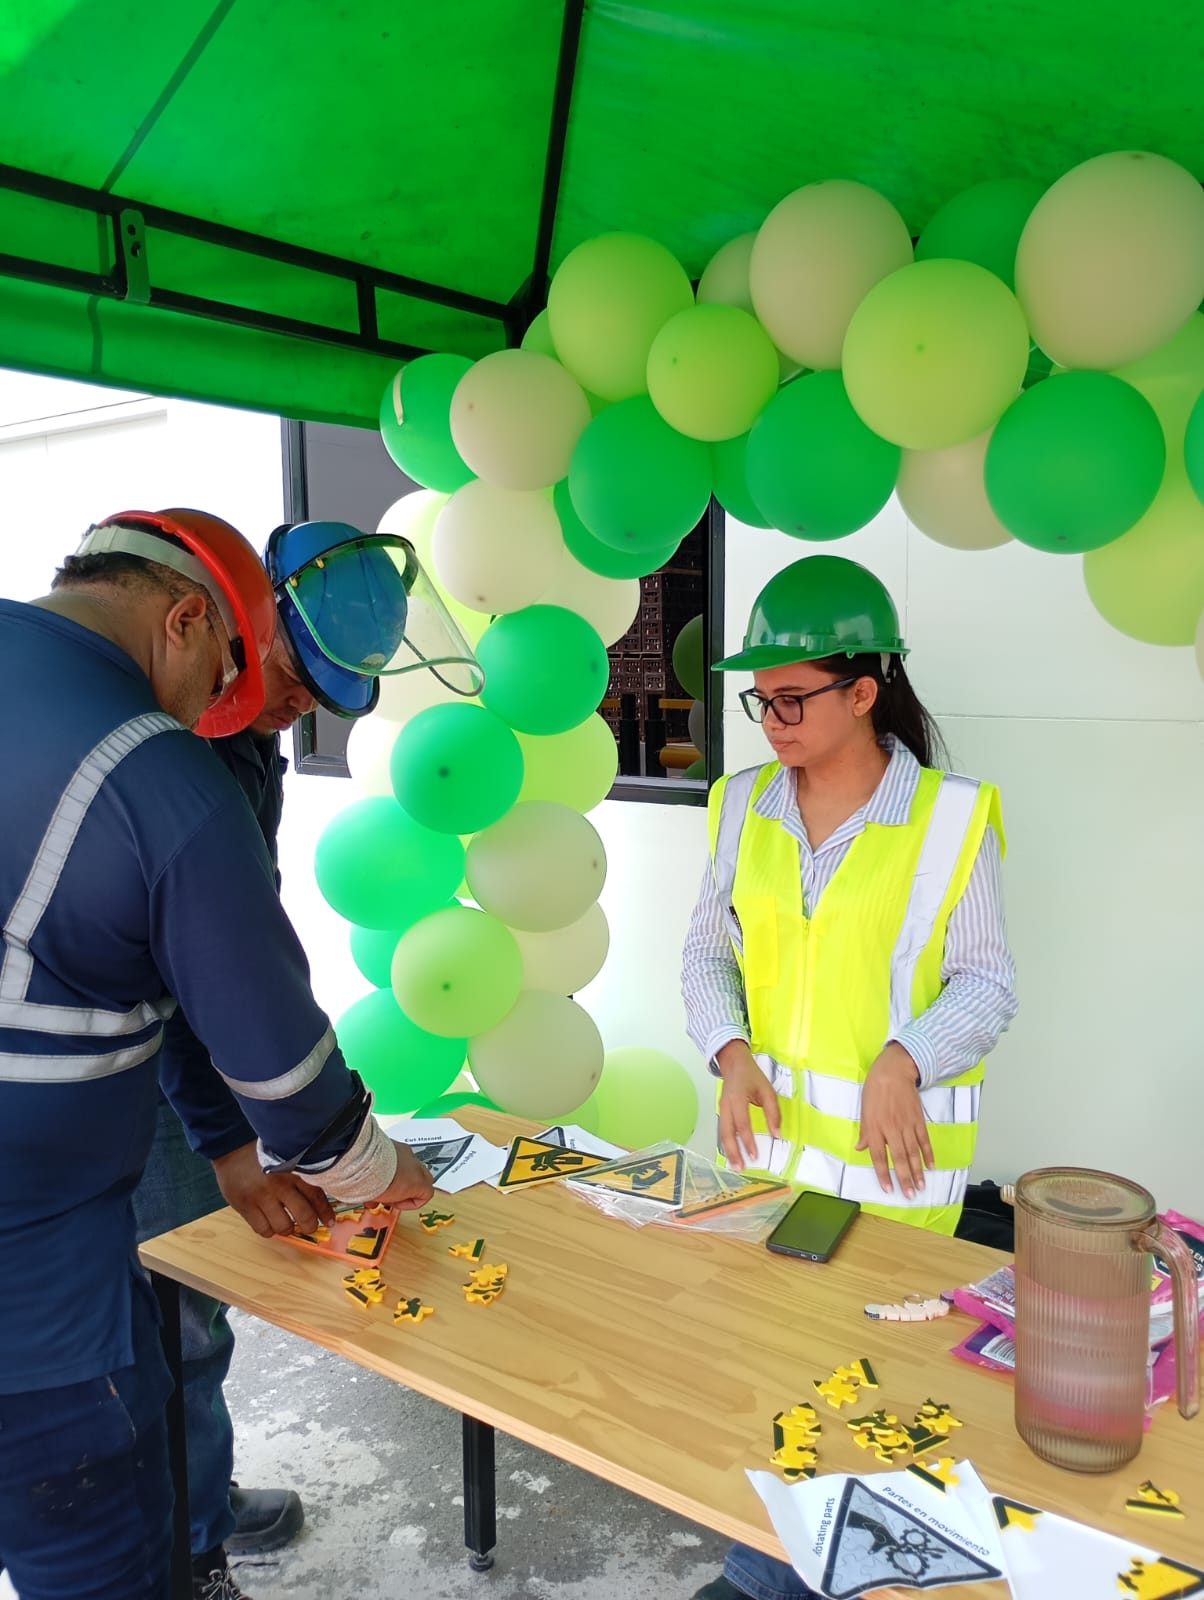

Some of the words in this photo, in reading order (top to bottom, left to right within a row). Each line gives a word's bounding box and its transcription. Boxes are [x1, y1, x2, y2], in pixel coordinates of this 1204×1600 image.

[823, 1497, 835, 1518] parts
[882, 1486, 913, 1508] Partes
[913, 1507, 927, 1518] en
[928, 1517, 991, 1556] movimiento
